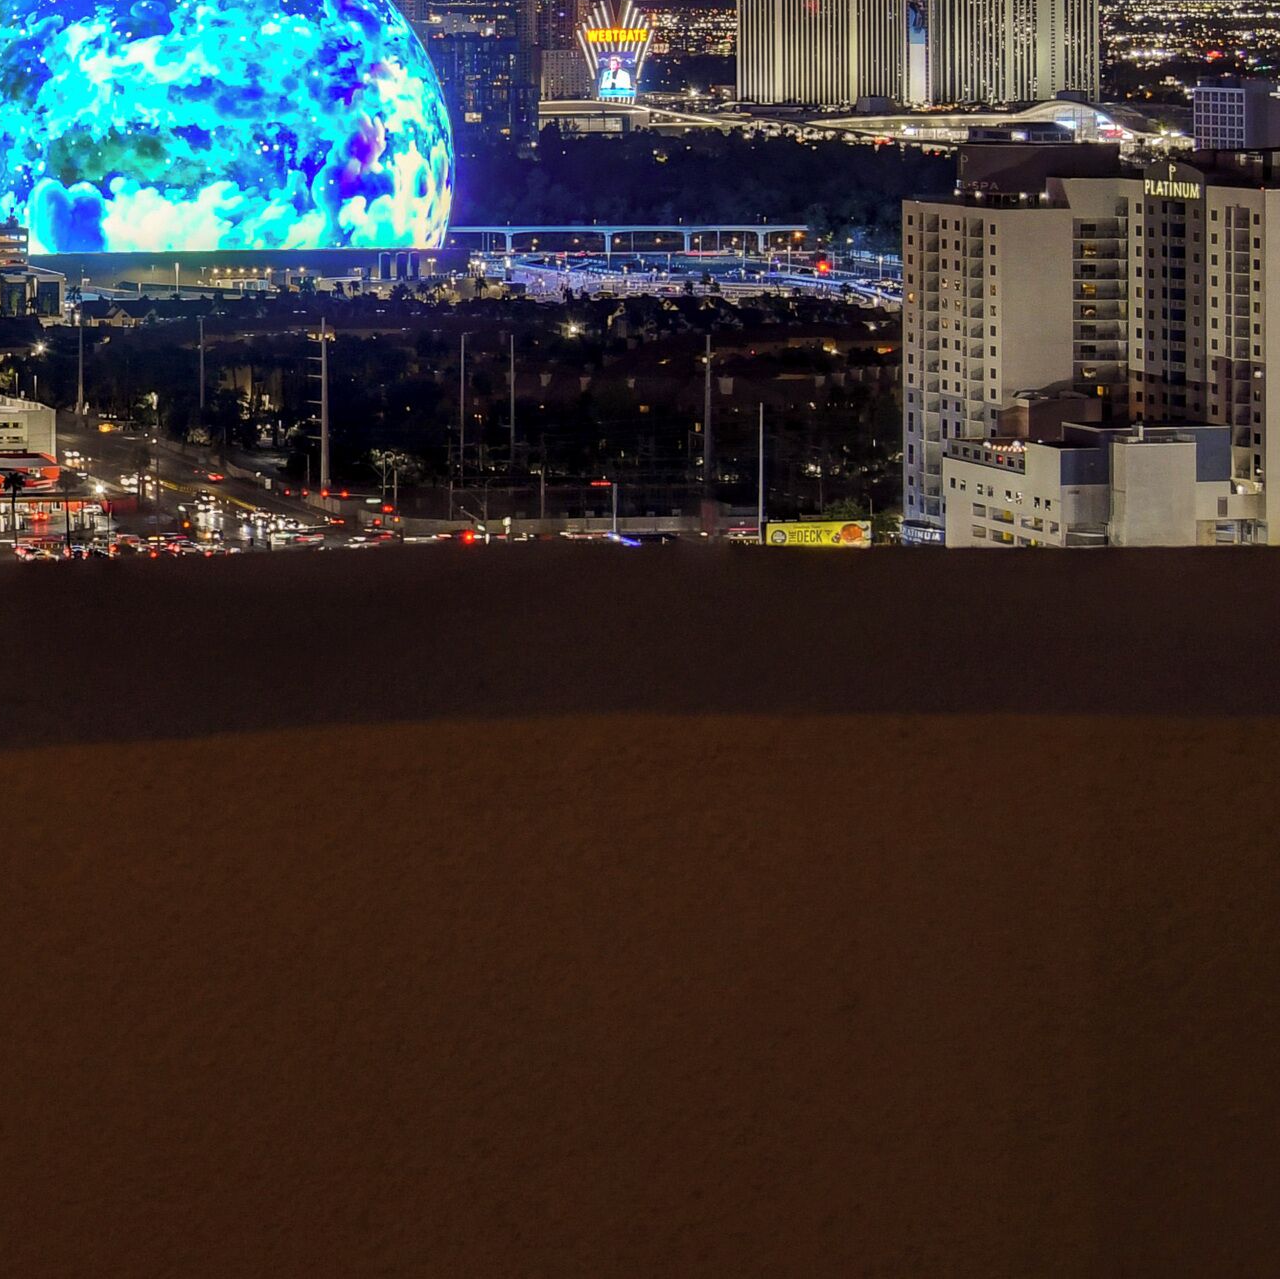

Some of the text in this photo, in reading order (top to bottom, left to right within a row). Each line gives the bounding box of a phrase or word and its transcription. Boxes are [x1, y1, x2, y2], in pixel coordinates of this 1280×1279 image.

[587, 29, 647, 42] WESTGATE
[1144, 179, 1200, 199] PLATINUM
[797, 529, 823, 544] DECK
